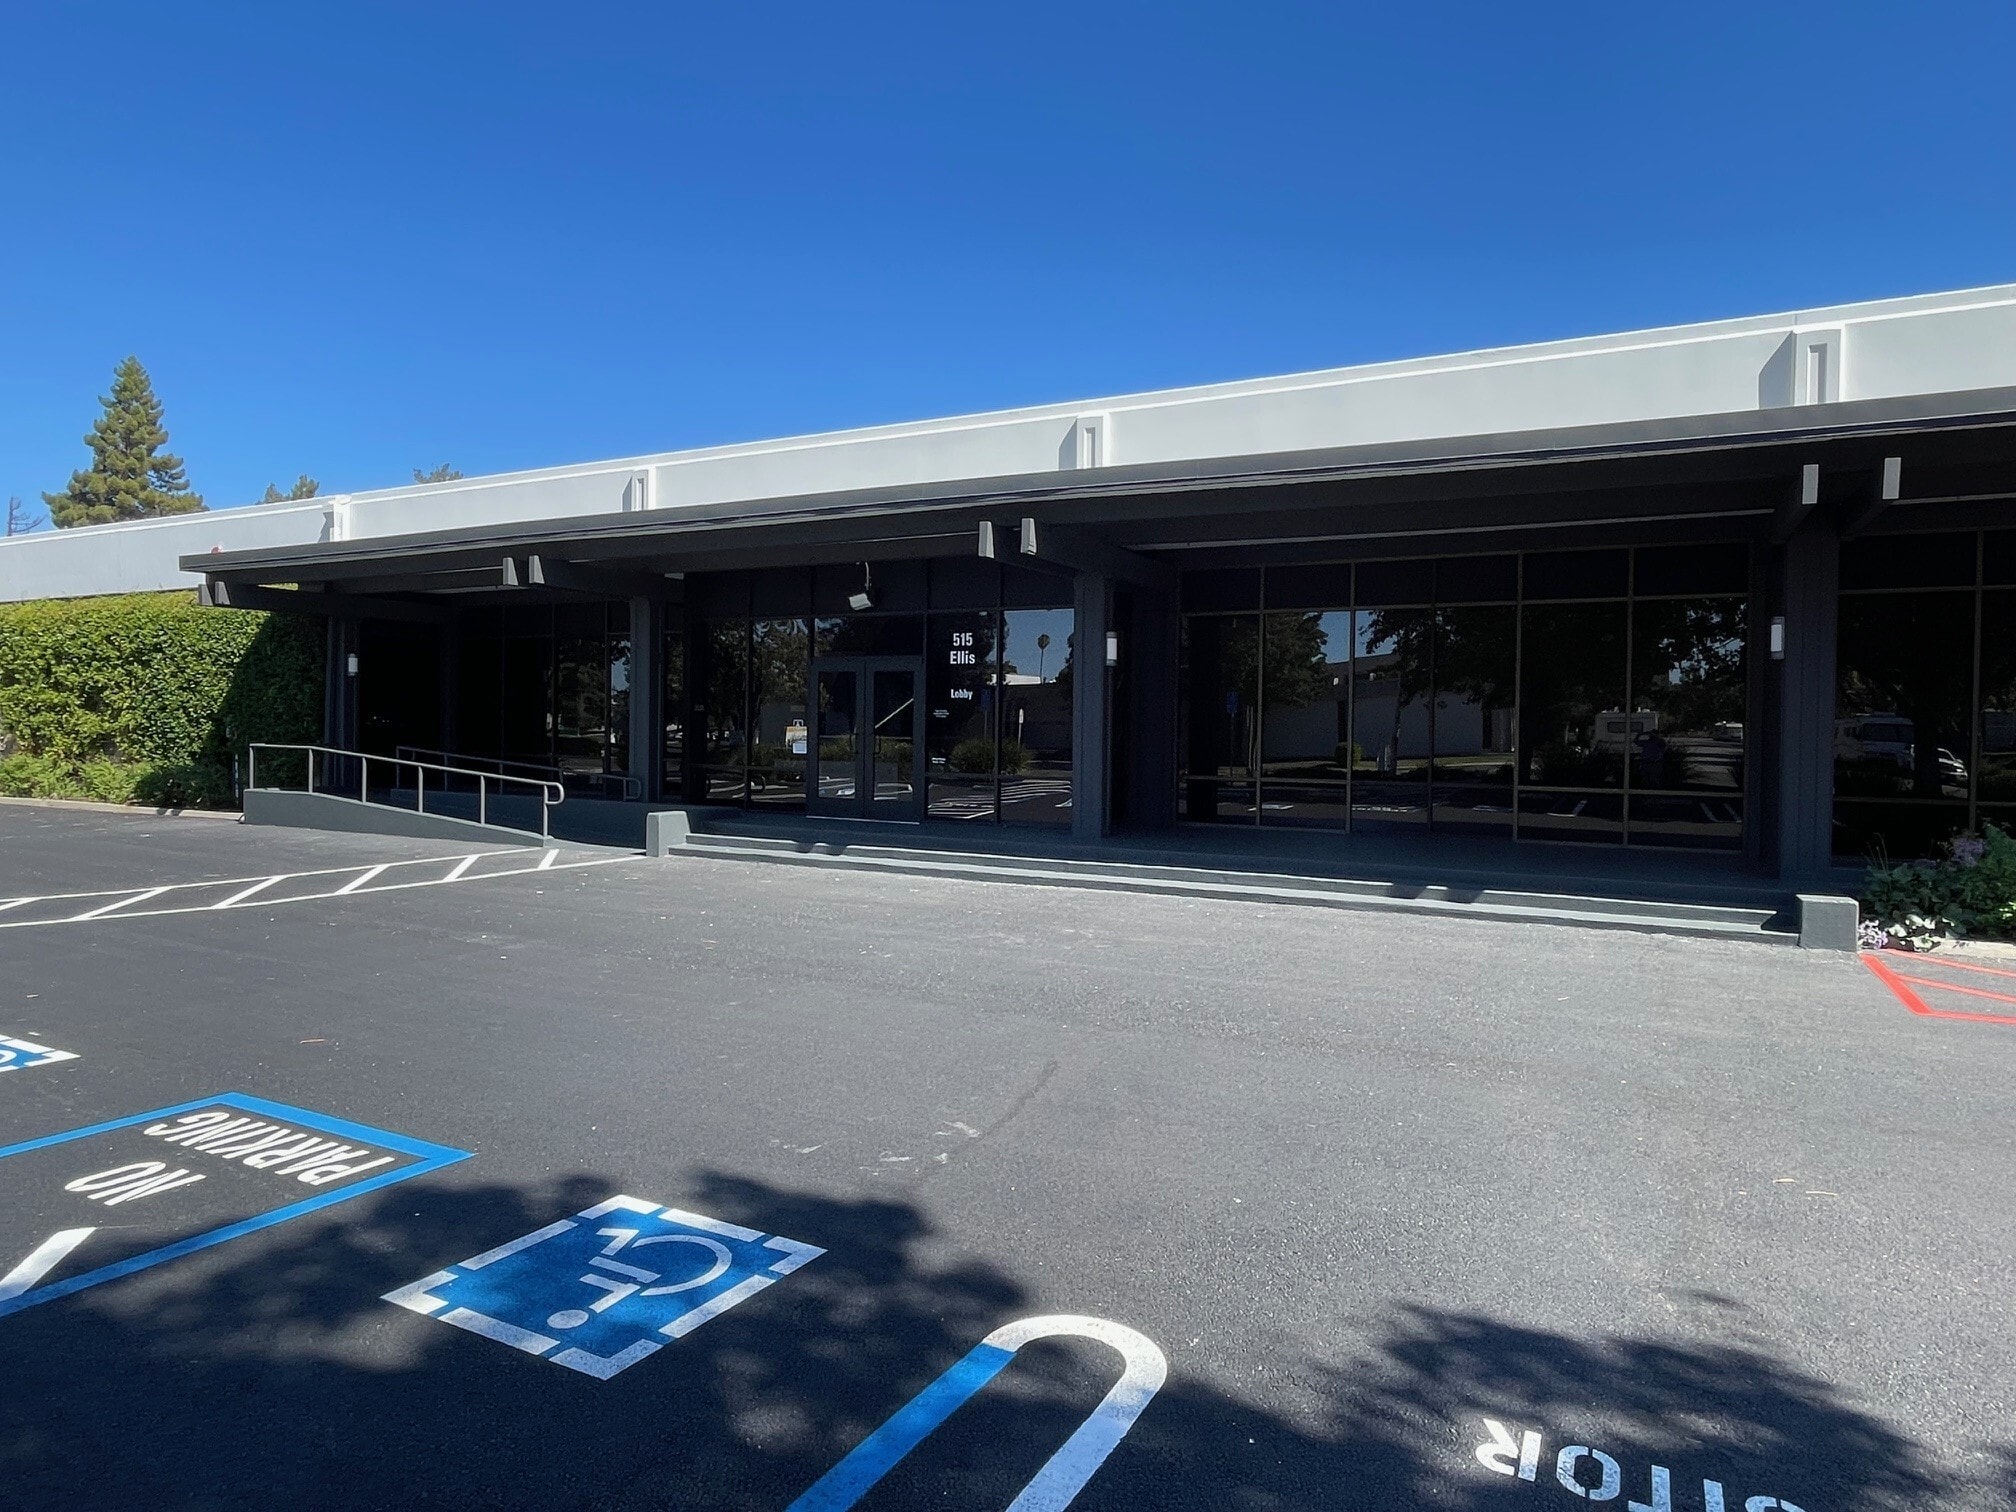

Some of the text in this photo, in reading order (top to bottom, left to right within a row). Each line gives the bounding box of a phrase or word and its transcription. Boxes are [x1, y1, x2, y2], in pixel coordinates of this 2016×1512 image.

[953, 633, 973, 646] 515
[950, 651, 975, 664] Ellis
[951, 689, 973, 700] Lobby
[144, 1111, 395, 1185] PARKING
[65, 1161, 206, 1206] NO
